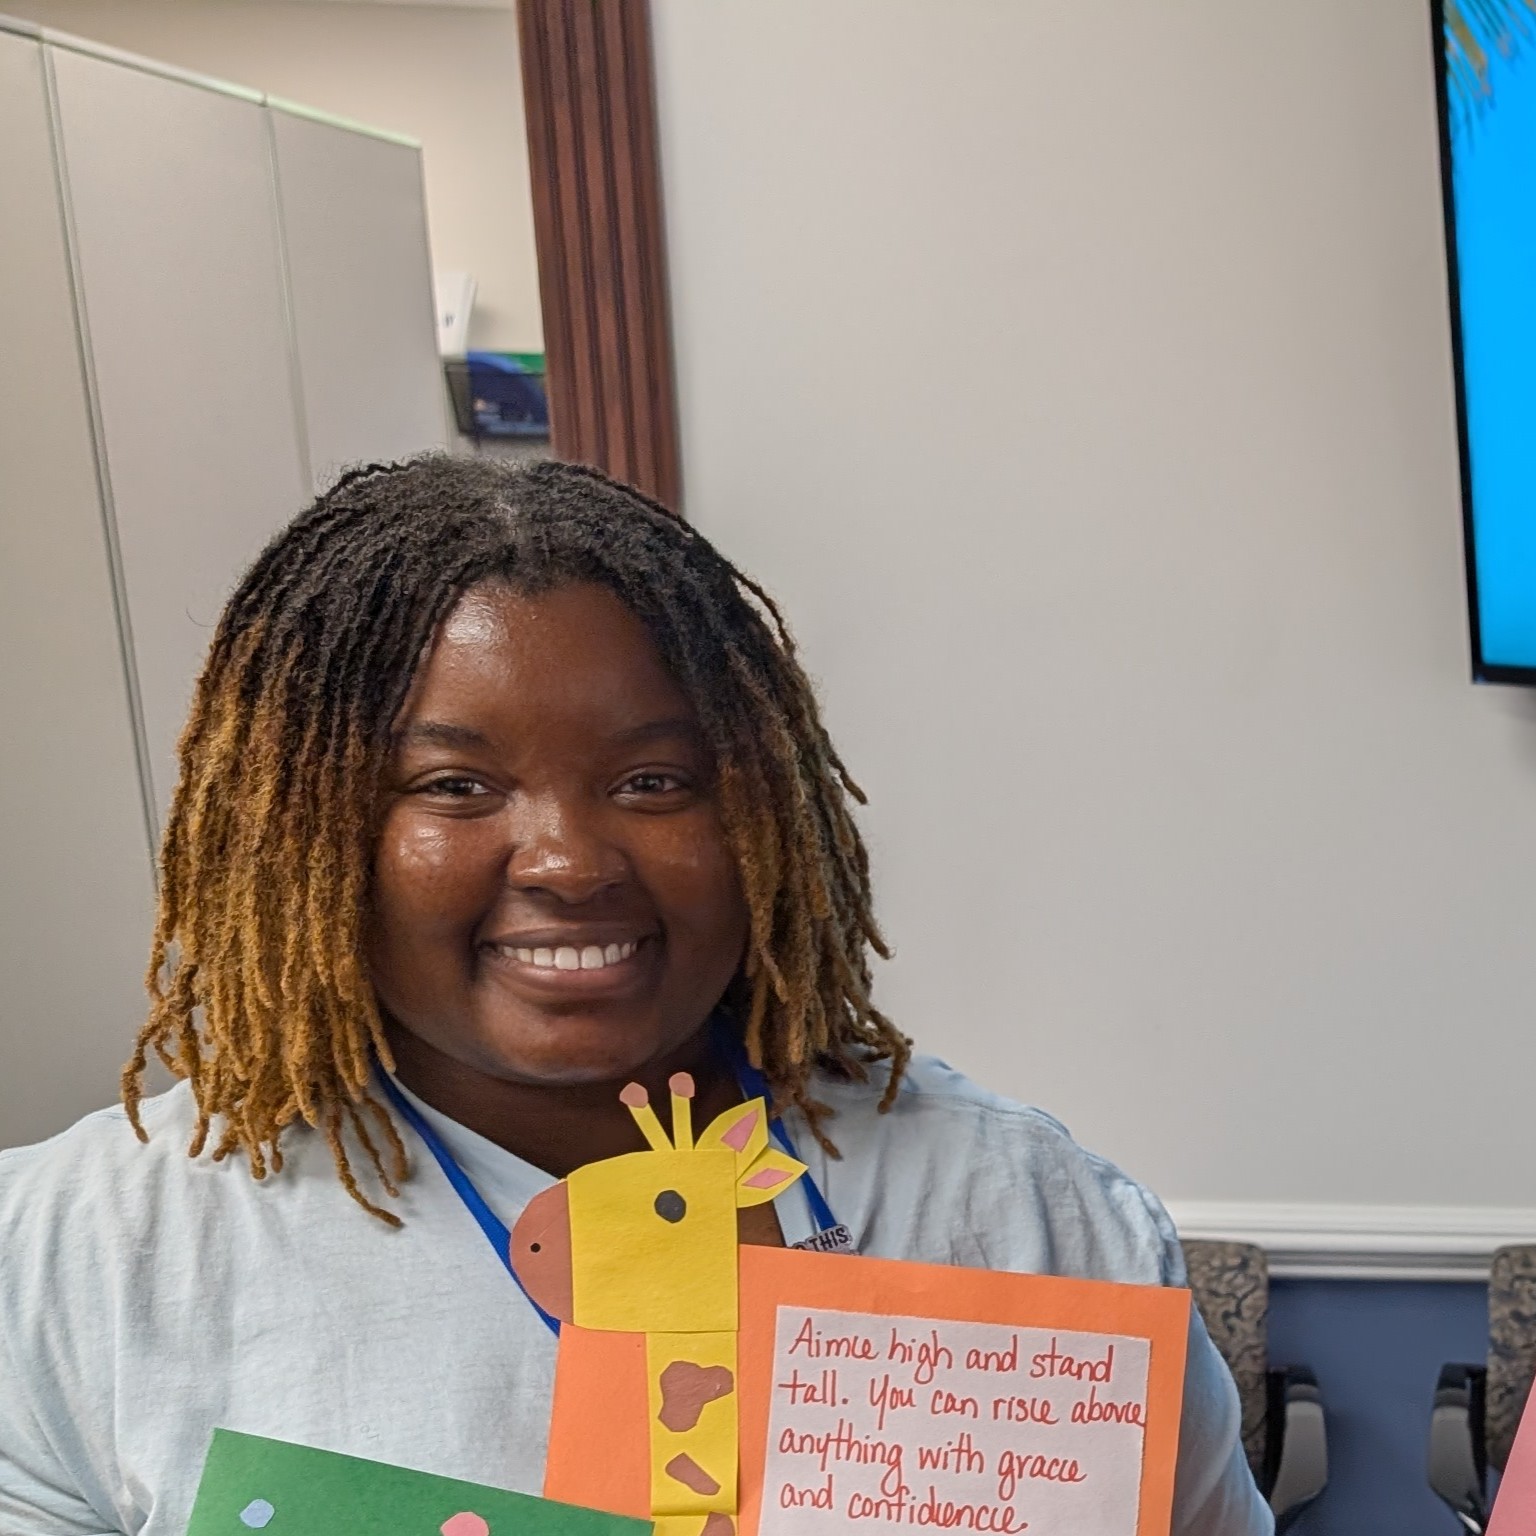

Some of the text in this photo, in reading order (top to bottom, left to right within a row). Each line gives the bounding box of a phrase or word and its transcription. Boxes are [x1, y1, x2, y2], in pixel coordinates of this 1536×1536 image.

[808, 1227, 849, 1252] THIS
[888, 1328, 952, 1385] high
[966, 1334, 1018, 1372] and
[1030, 1337, 1114, 1383] stand
[778, 1369, 1147, 1431] tall. You can rise above
[779, 1418, 1088, 1501] anything with grace
[780, 1474, 834, 1510] and
